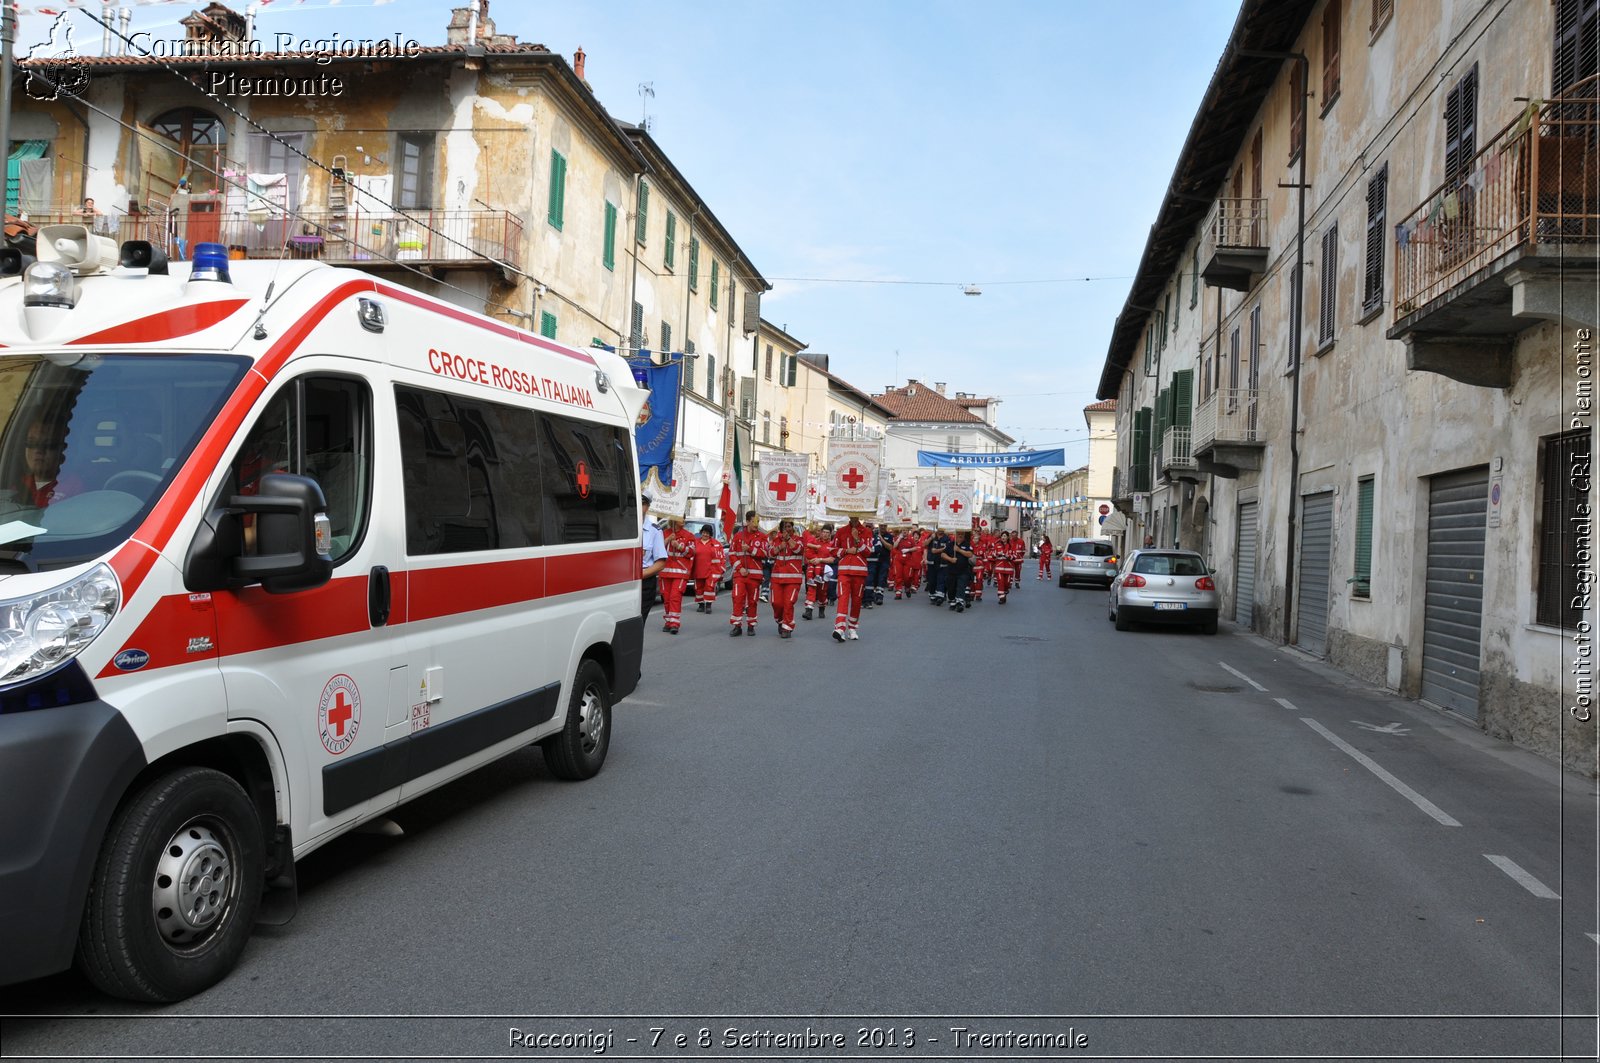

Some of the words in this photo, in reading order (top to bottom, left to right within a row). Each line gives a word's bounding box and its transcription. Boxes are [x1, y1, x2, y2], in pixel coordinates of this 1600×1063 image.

[428, 348, 490, 385] CROCE
[490, 364, 541, 396] ROSSA
[541, 377, 594, 409] ITALIANA
[949, 456, 1031, 464] ARRIVEDERCI
[320, 689, 330, 717] CROCE
[328, 676, 344, 692] ROSSA
[343, 677, 360, 708] ITALIANA
[412, 705, 421, 718] CN
[321, 720, 359, 752] RACCONIGI
